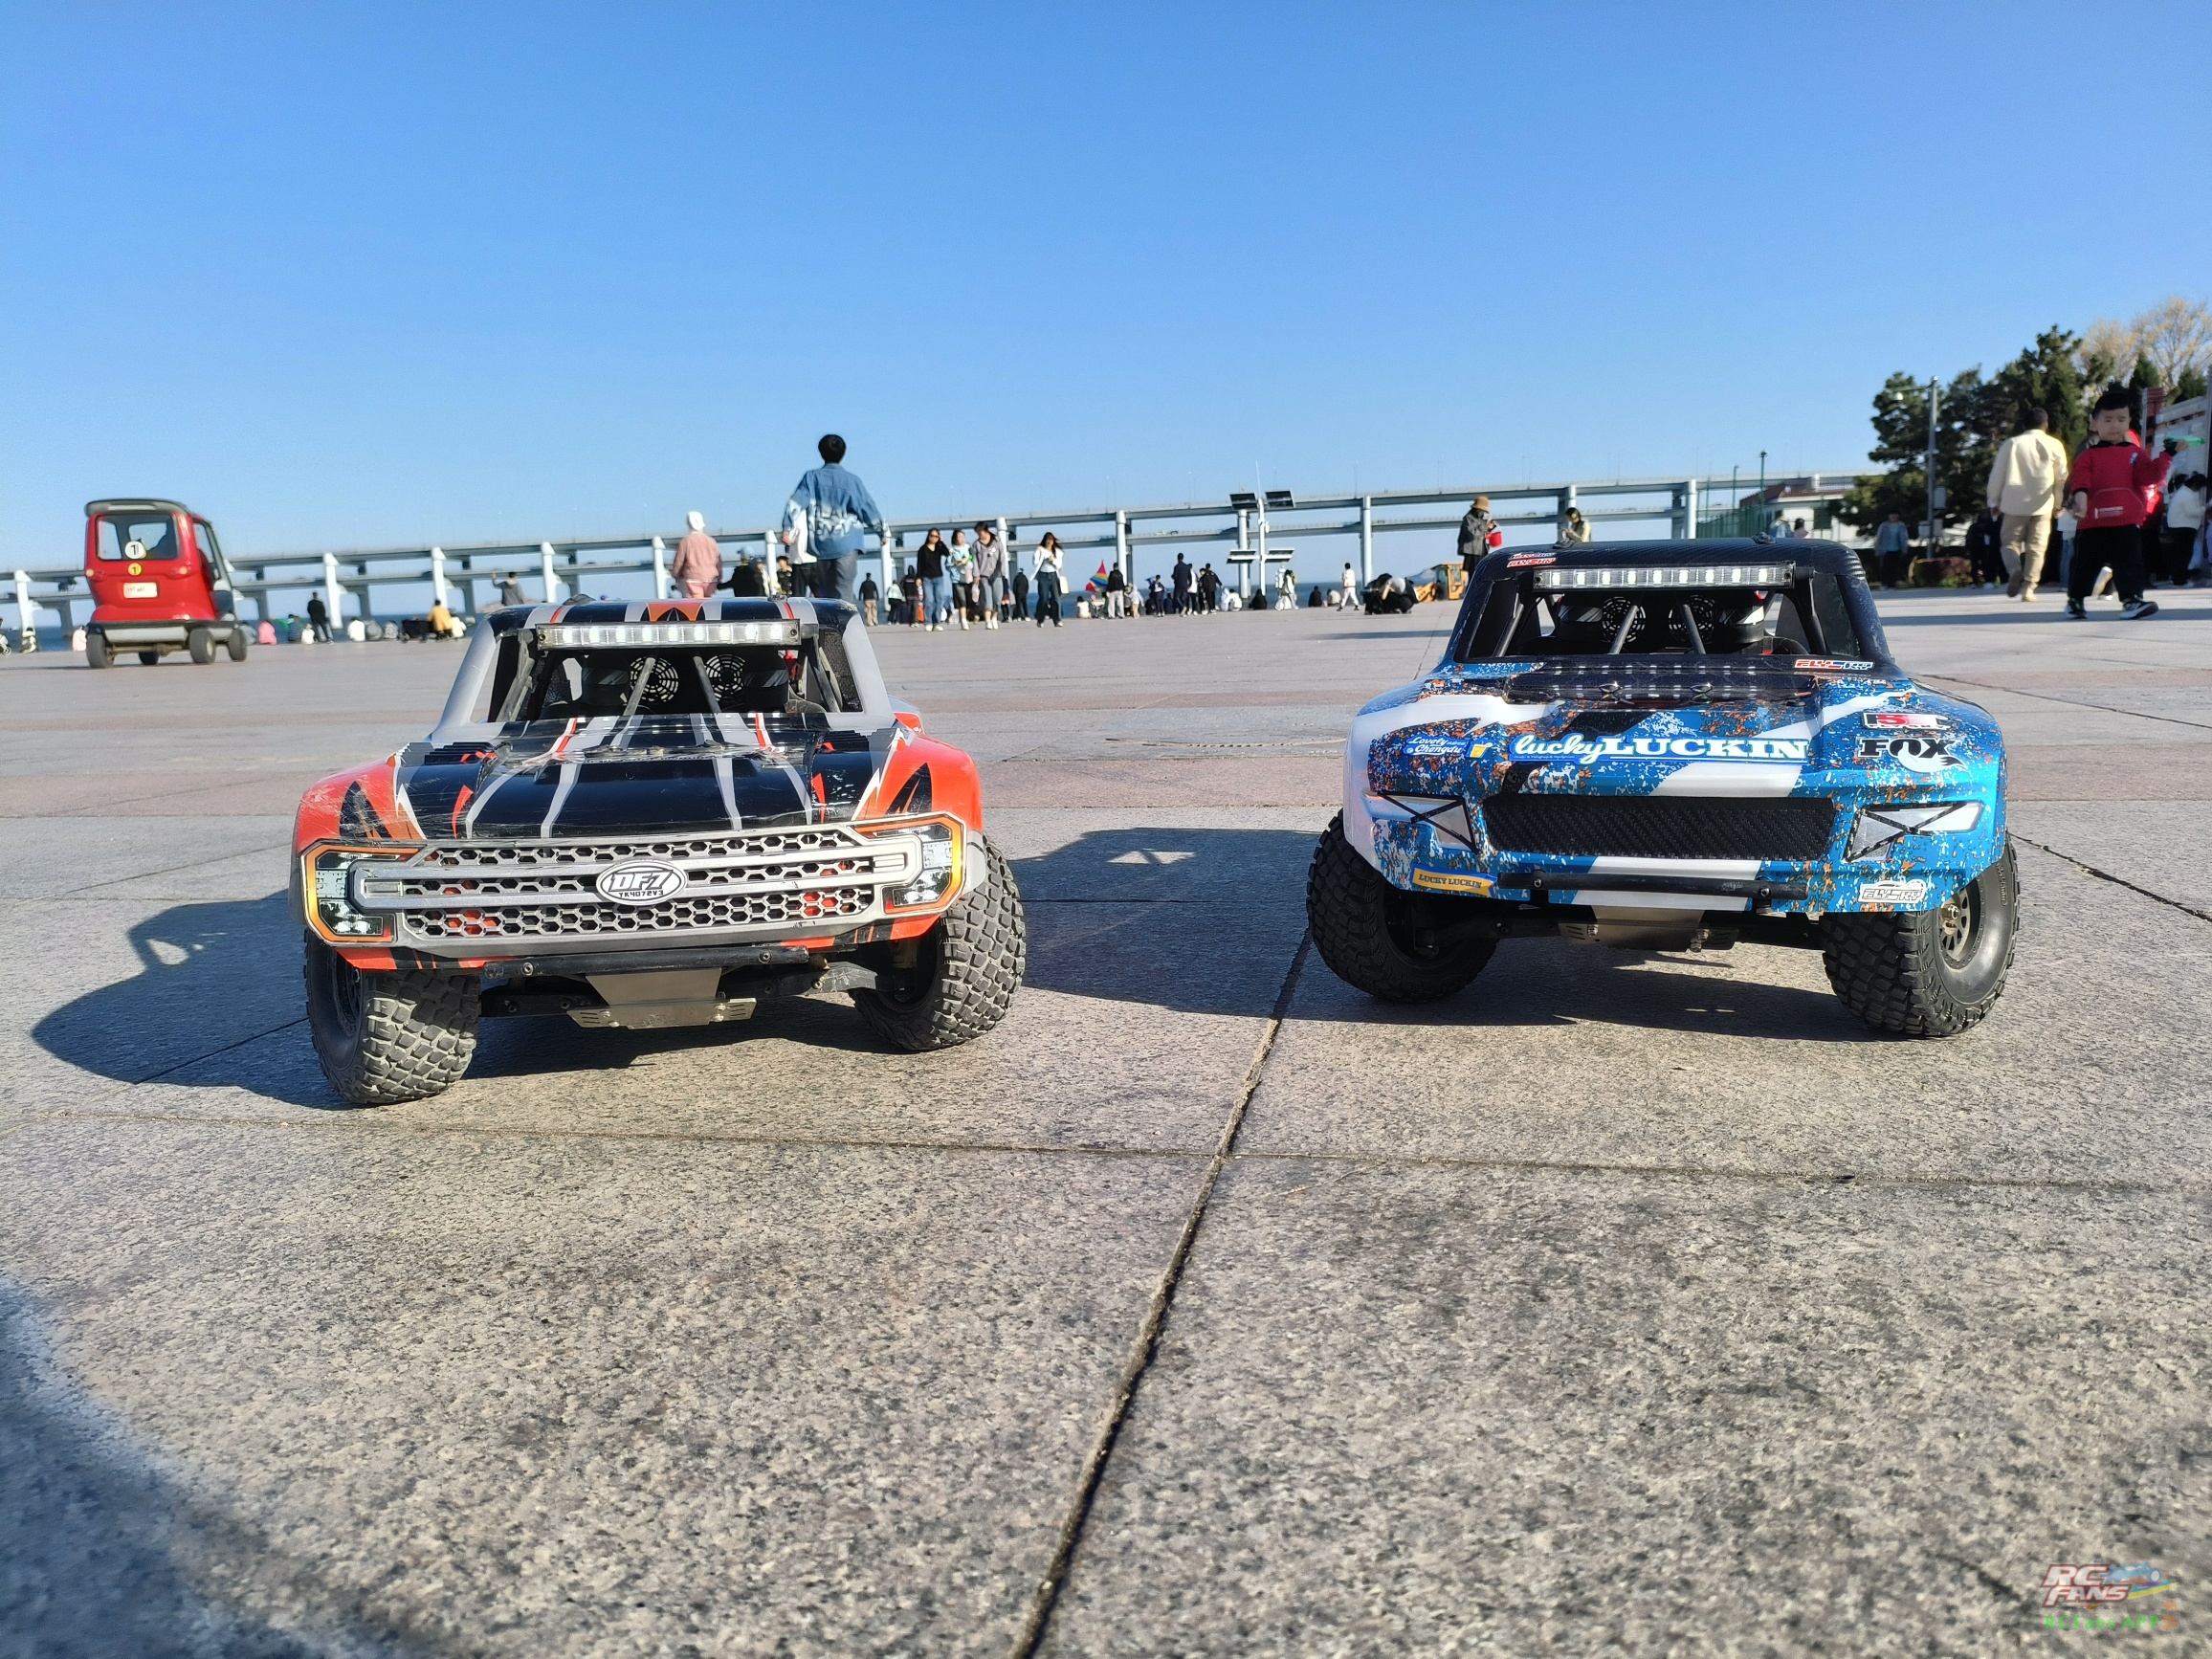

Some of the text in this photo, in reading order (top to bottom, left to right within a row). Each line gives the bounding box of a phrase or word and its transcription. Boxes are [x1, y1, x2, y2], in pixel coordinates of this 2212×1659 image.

[1408, 736, 1448, 747] Lovely
[1859, 738, 1958, 759] FOX
[608, 870, 673, 892] DF7
[1419, 874, 1482, 889] LUCKY LUCKIN
